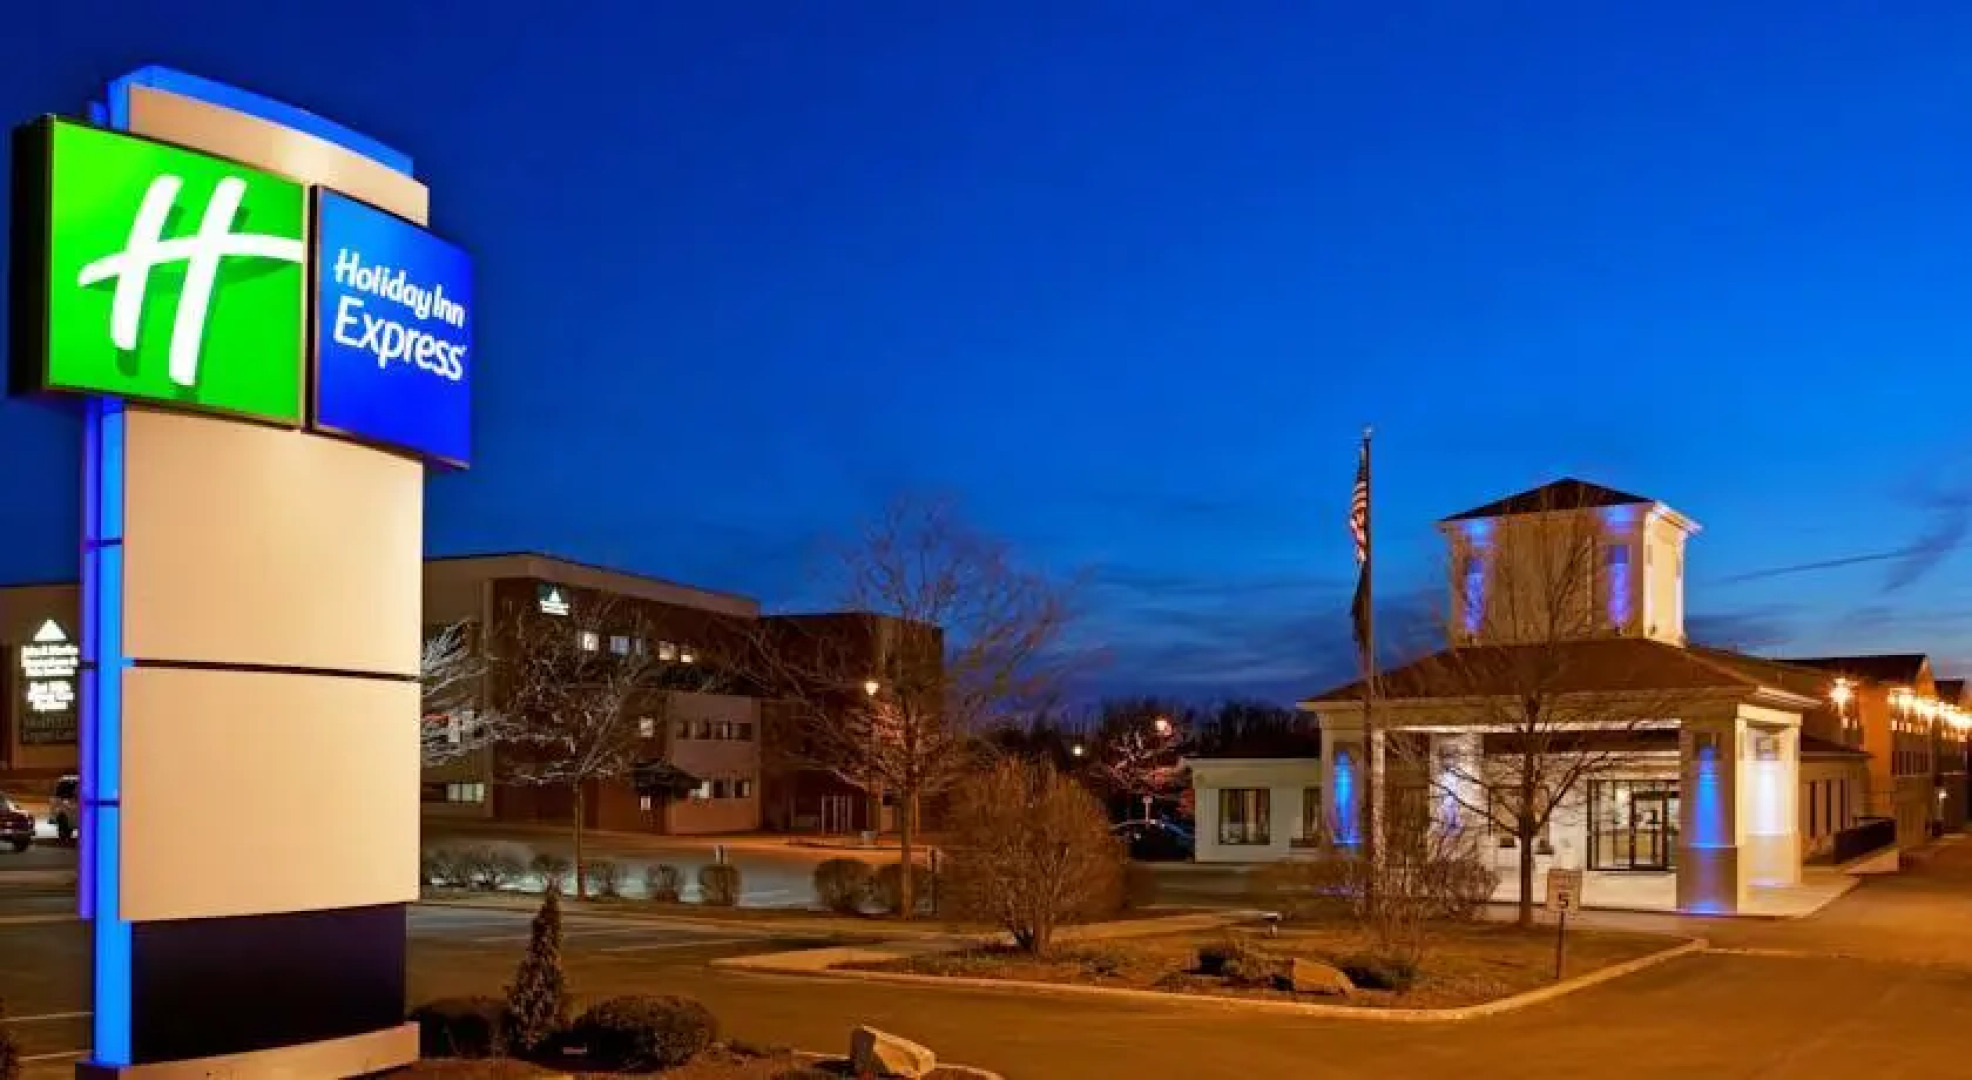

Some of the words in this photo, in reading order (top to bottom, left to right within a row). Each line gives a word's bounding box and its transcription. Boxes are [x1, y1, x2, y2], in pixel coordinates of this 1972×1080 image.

[77, 175, 304, 386] H
[333, 248, 433, 320] Holiday
[431, 283, 466, 329] Inn
[333, 295, 465, 381] Express
[1558, 891, 1569, 909] 5
